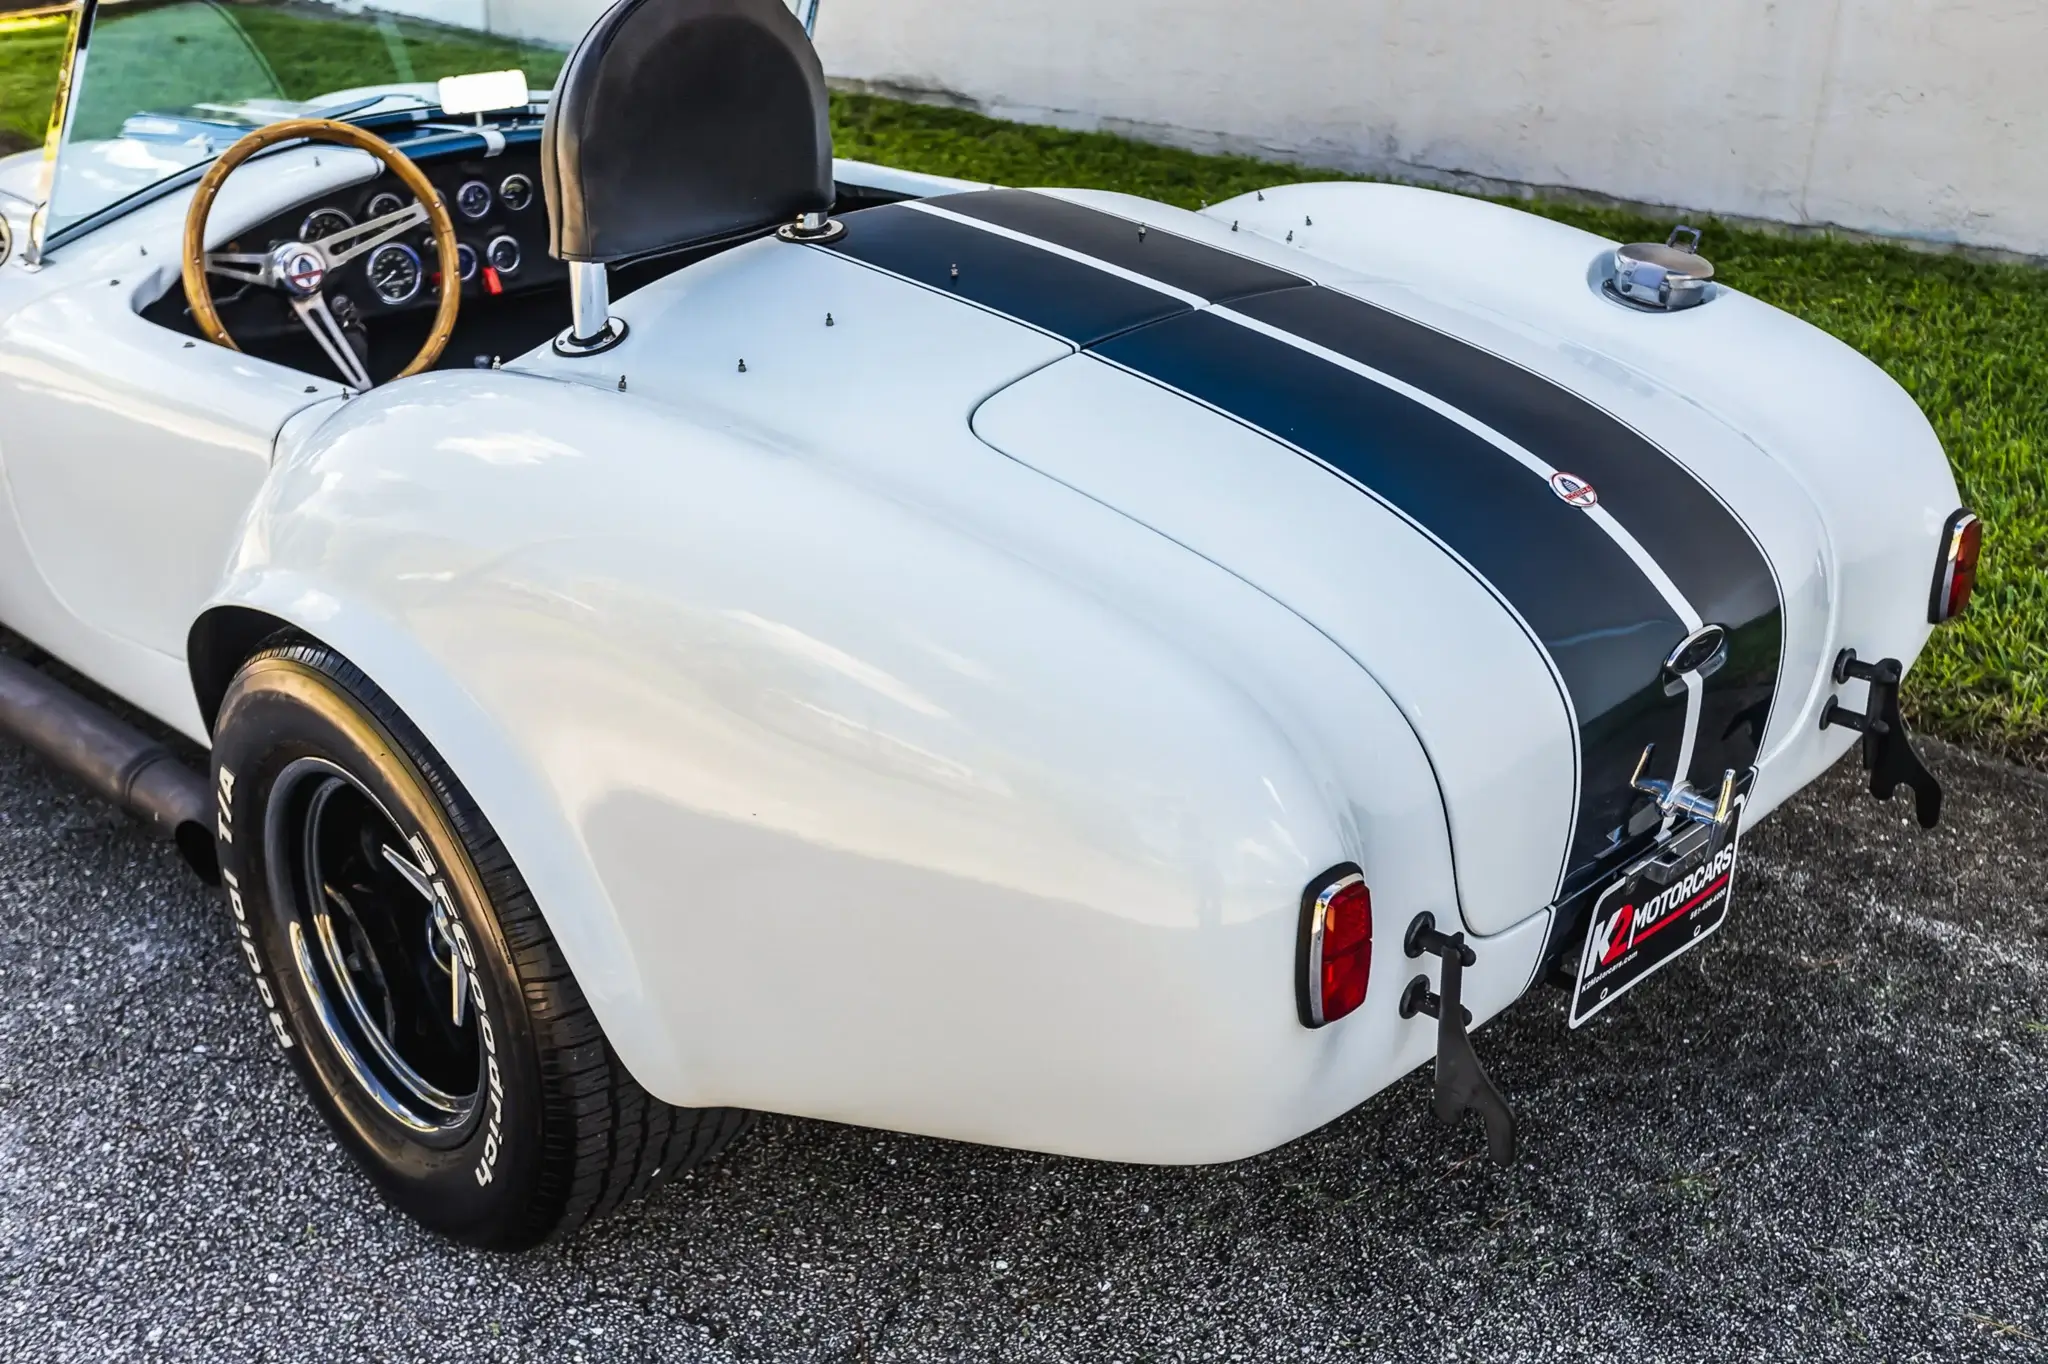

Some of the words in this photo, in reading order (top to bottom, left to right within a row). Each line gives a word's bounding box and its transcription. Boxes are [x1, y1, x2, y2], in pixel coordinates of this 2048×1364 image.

[217, 764, 236, 844] T/A
[223, 867, 294, 1049] Radial
[1584, 904, 1634, 978] K2
[1628, 842, 1733, 949] MOTORCARS
[409, 834, 503, 1187] BFGoodrich
